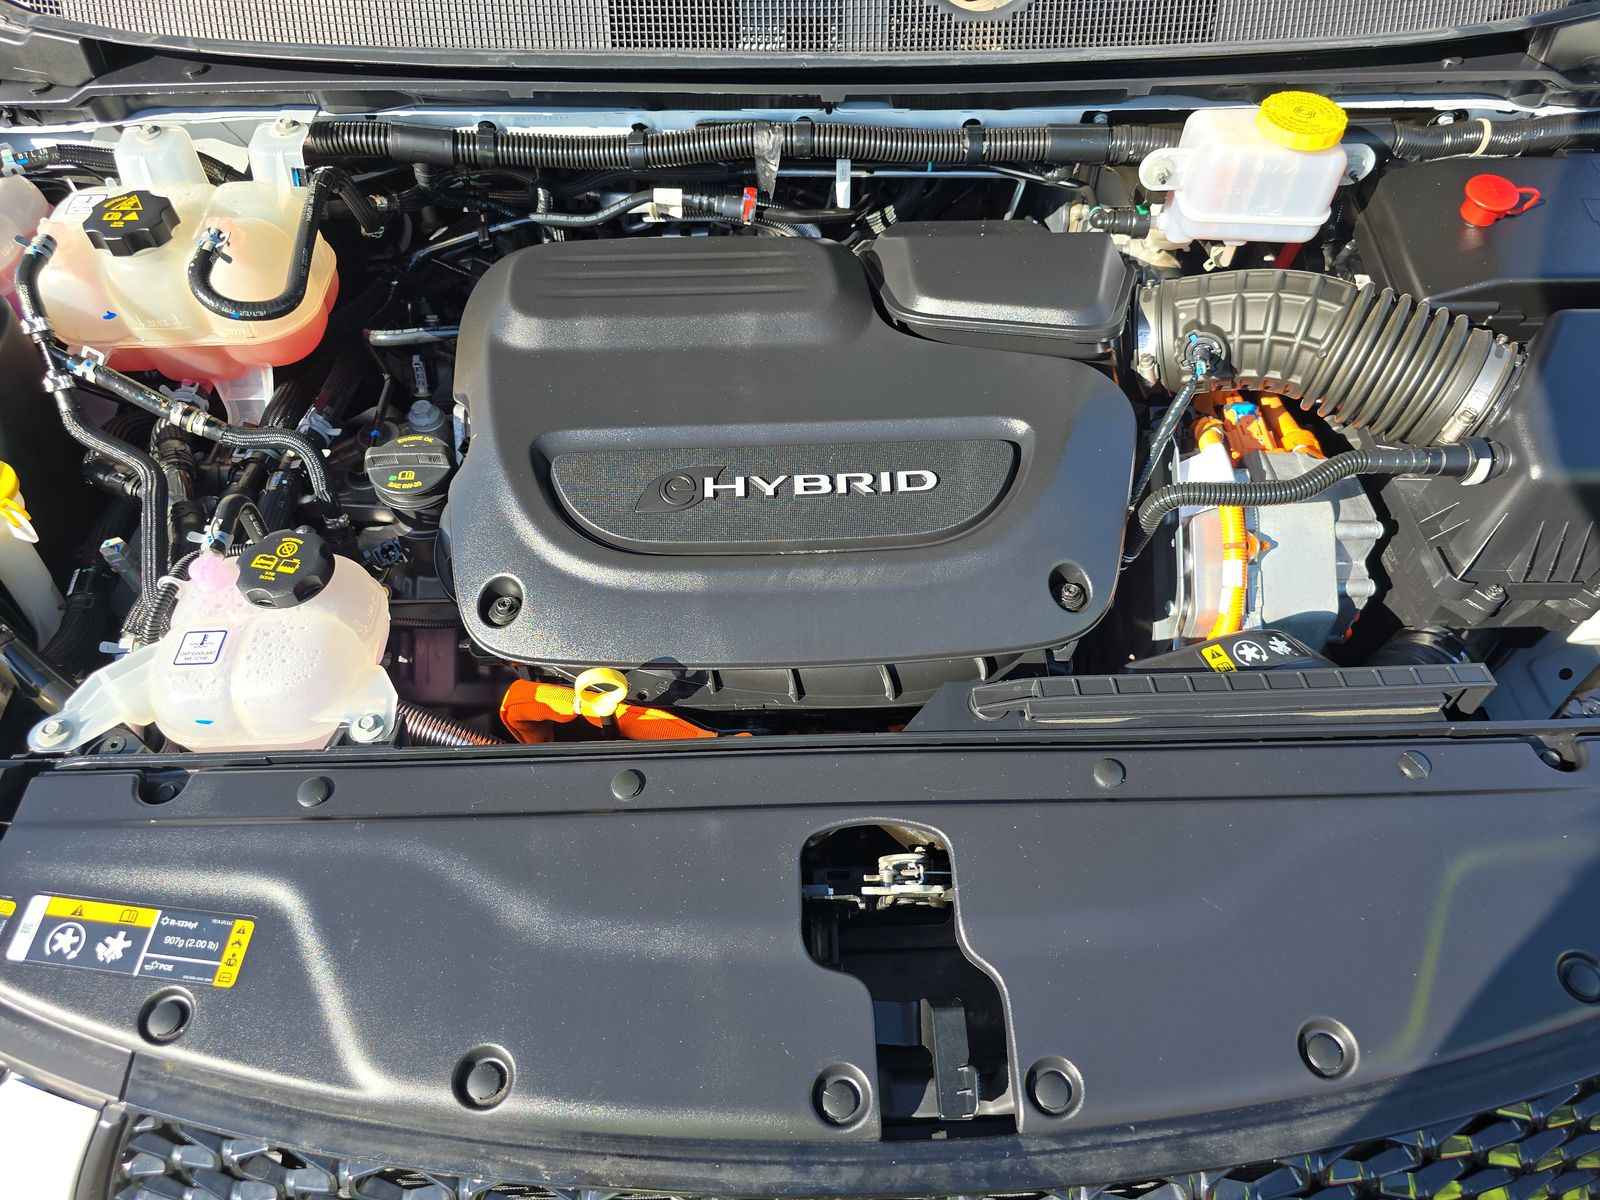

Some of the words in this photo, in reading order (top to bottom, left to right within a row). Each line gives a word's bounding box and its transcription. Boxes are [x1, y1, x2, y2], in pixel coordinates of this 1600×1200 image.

[397, 435, 423, 444] ENGINE
[423, 436, 434, 444] OIL
[169, 919, 199, 930] R-1234yf
[163, 935, 185, 948] 907g
[186, 937, 207, 949] (2.00
[207, 940, 219, 951] lb)
